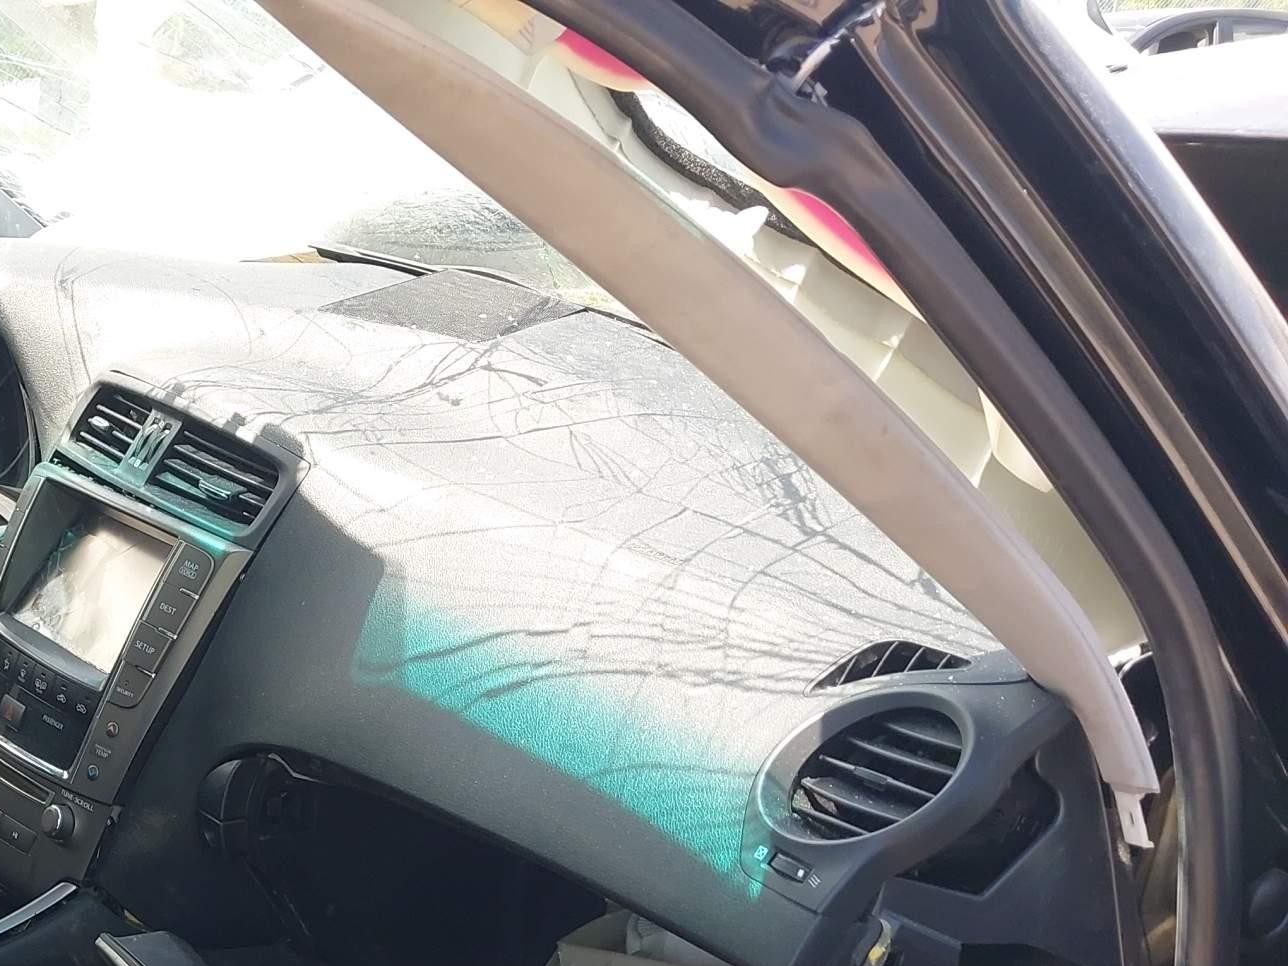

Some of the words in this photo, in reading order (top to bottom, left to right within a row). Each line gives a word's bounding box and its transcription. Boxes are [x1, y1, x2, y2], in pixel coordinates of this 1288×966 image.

[183, 559, 199, 571] MAP
[159, 602, 176, 616] DEST
[134, 640, 156, 654] SETUP
